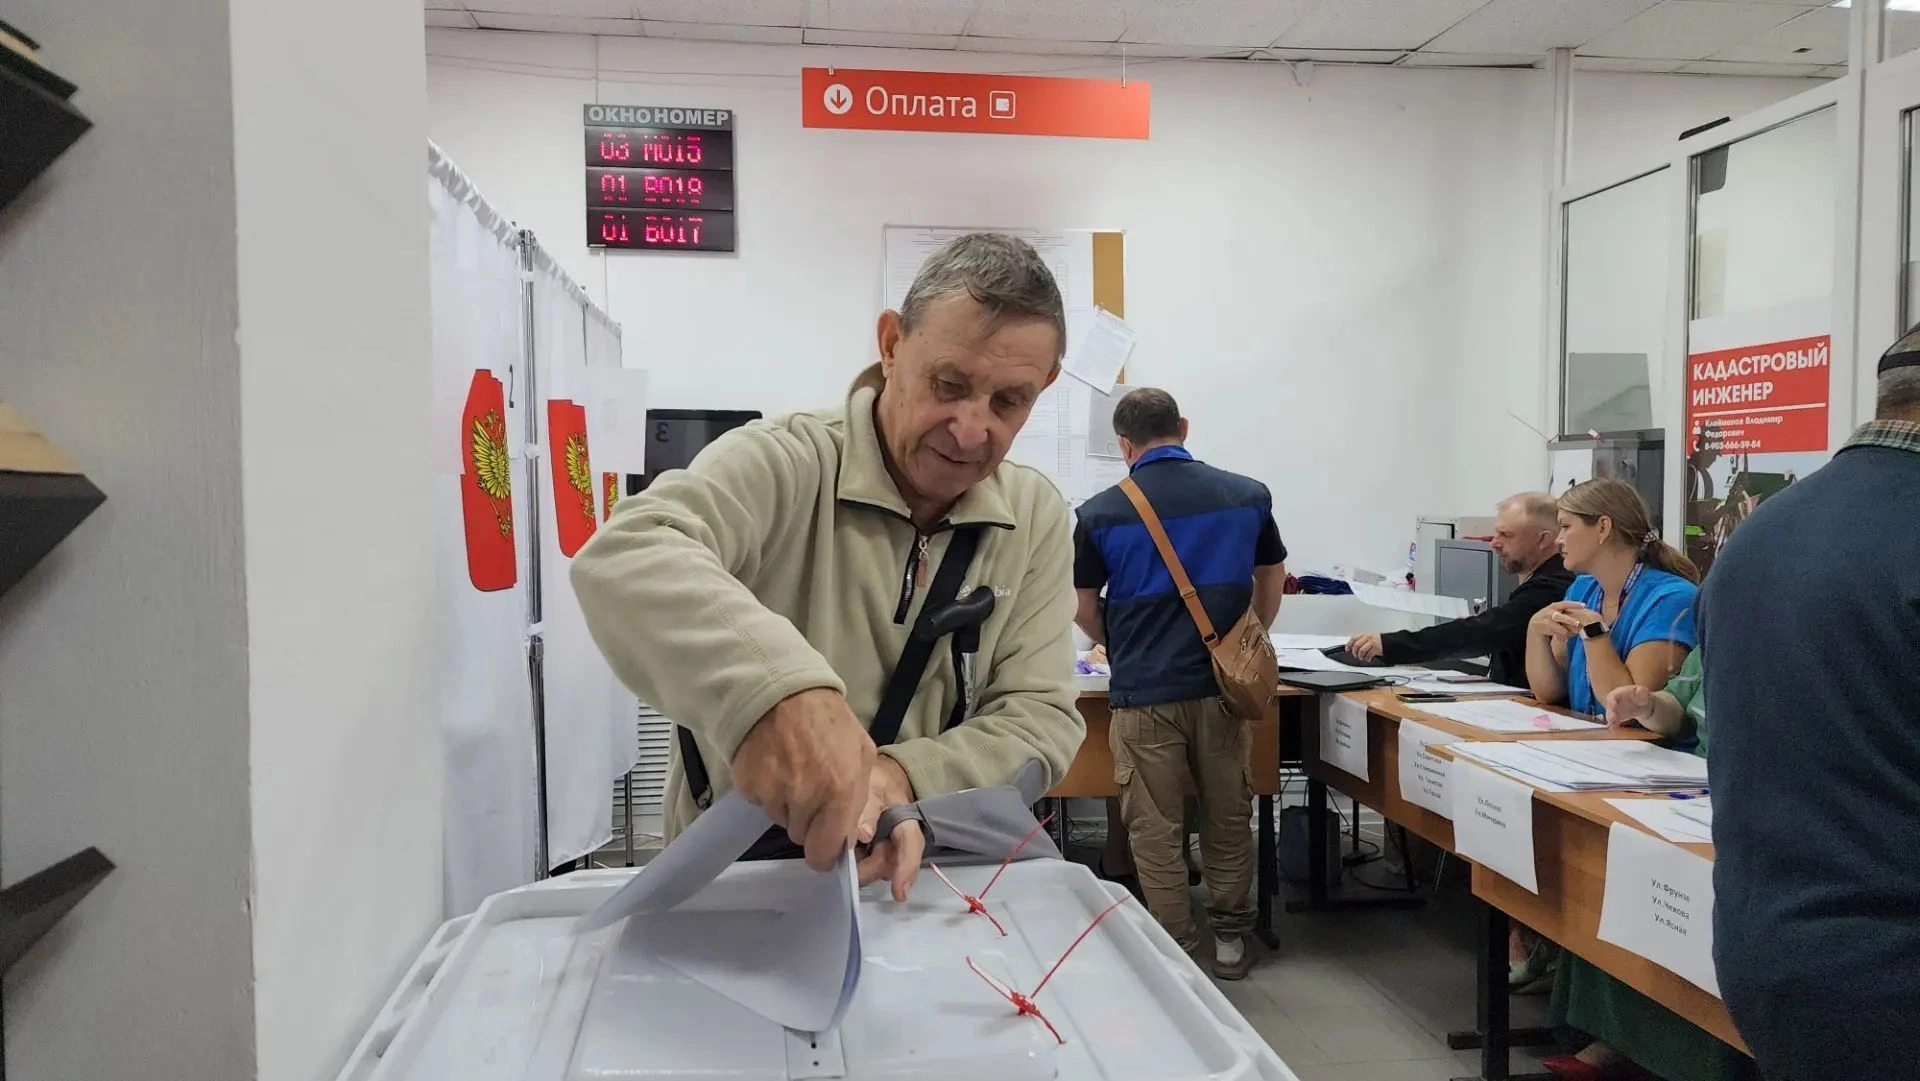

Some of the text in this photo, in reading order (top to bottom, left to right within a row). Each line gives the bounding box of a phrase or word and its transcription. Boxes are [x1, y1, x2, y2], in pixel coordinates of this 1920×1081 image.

[865, 86, 977, 118] Оплата
[588, 106, 729, 126] ОКНО НОМЕР
[601, 174, 628, 201] 01
[602, 214, 629, 241] 01
[1693, 342, 1828, 381] КАДАСТРОВЫЙ
[1692, 381, 1774, 407] ИНЖЕНЕР
[1745, 415, 1784, 426] Владимир
